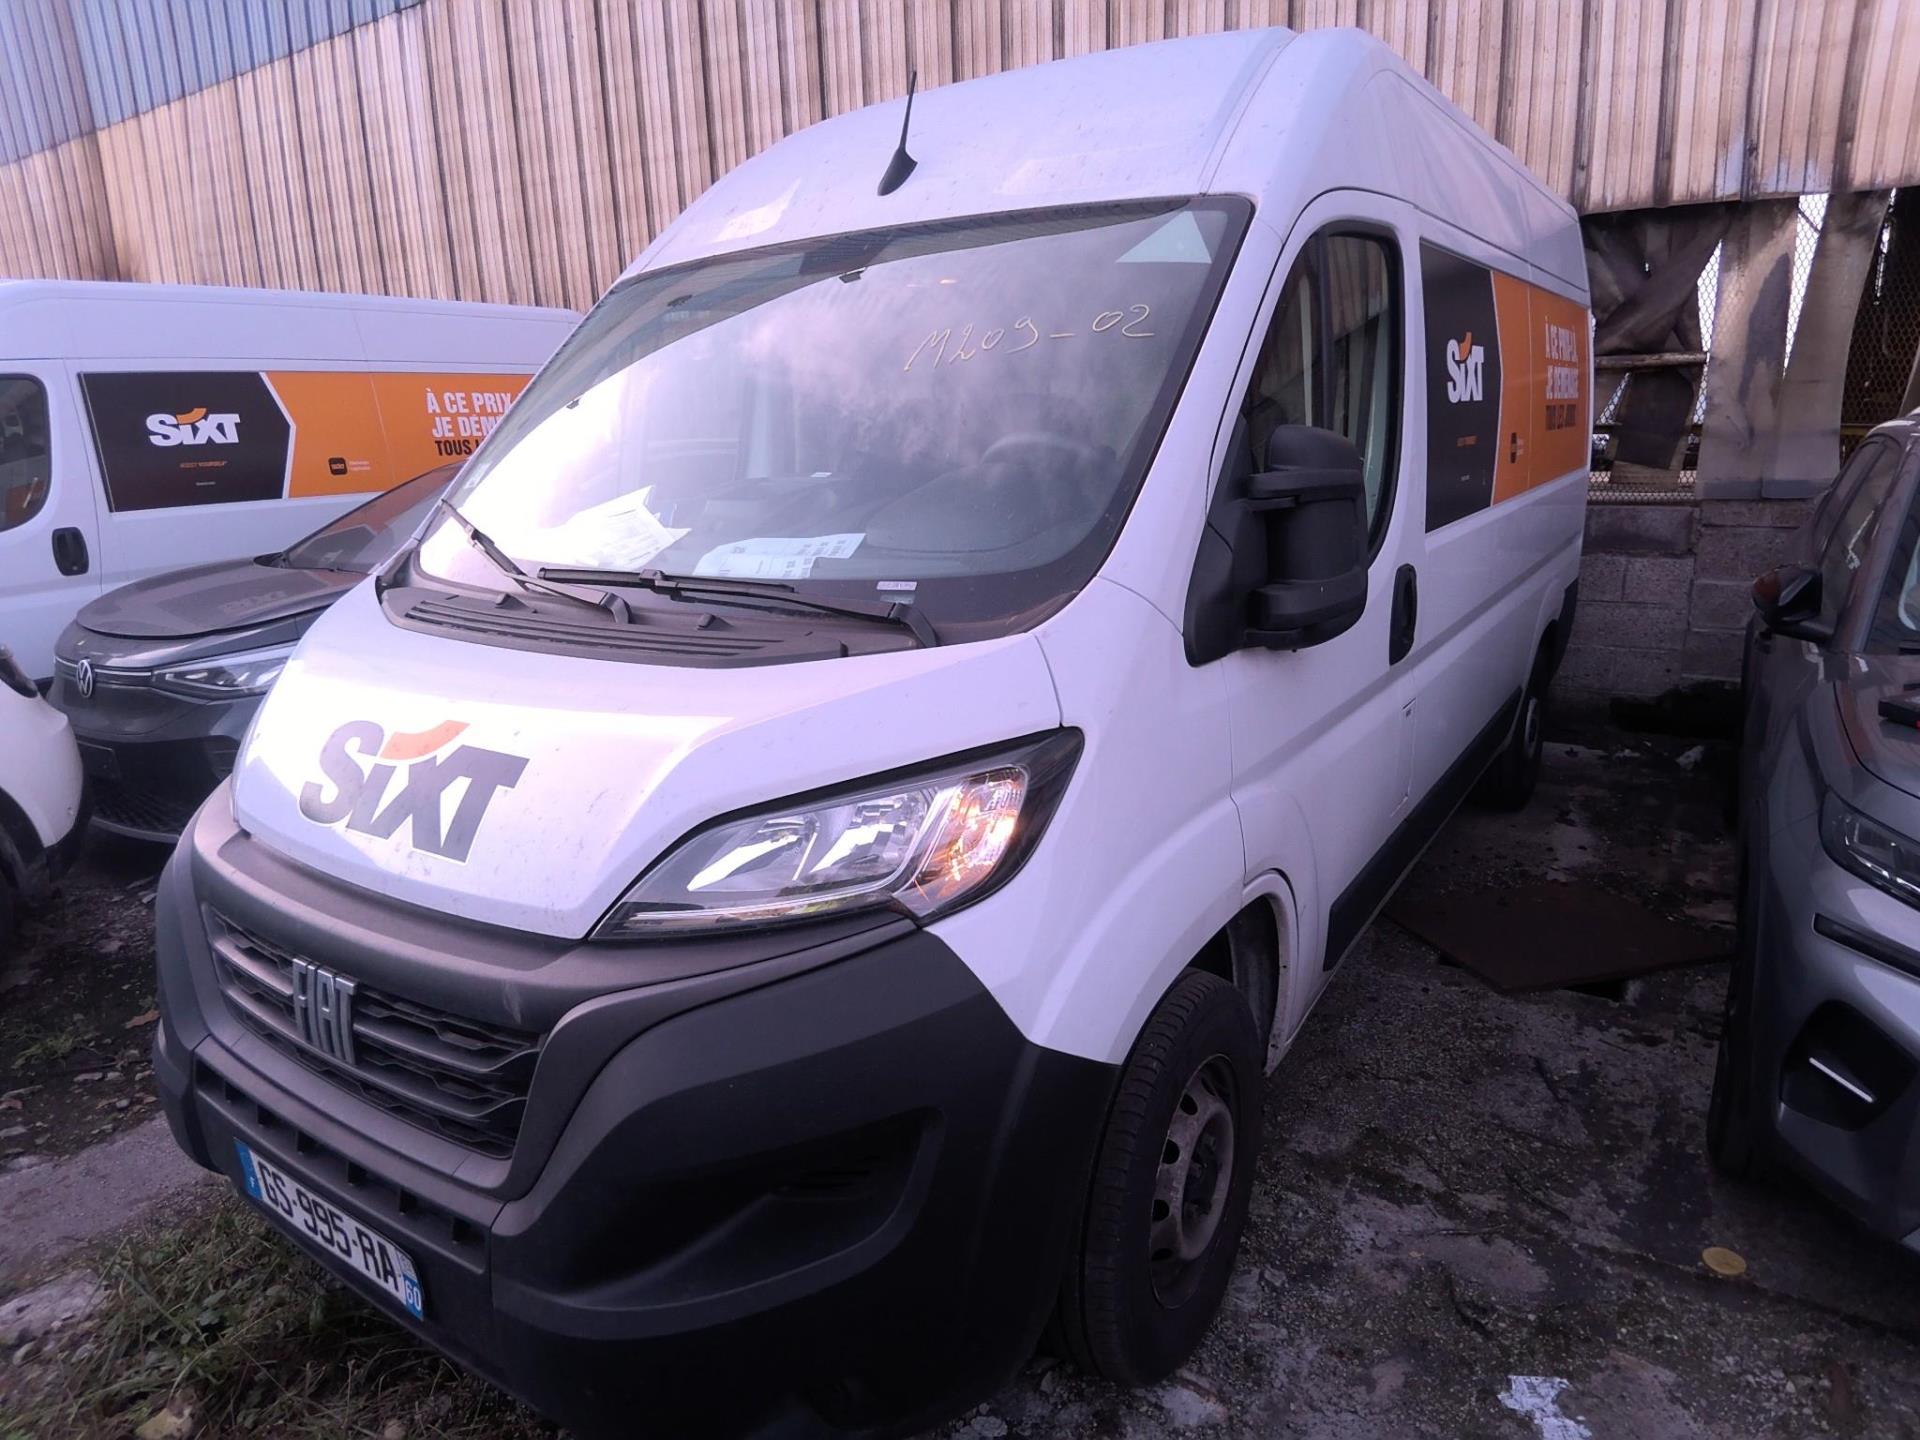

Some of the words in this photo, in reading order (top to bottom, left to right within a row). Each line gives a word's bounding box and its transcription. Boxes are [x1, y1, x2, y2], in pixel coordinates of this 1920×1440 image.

[443, 392, 470, 414] CE
[432, 416, 455, 438] JE
[457, 414, 504, 437] DÉM
[434, 439, 473, 457] TOUS
[292, 957, 356, 1067] FIAT
[404, 1280, 422, 1312] 60
